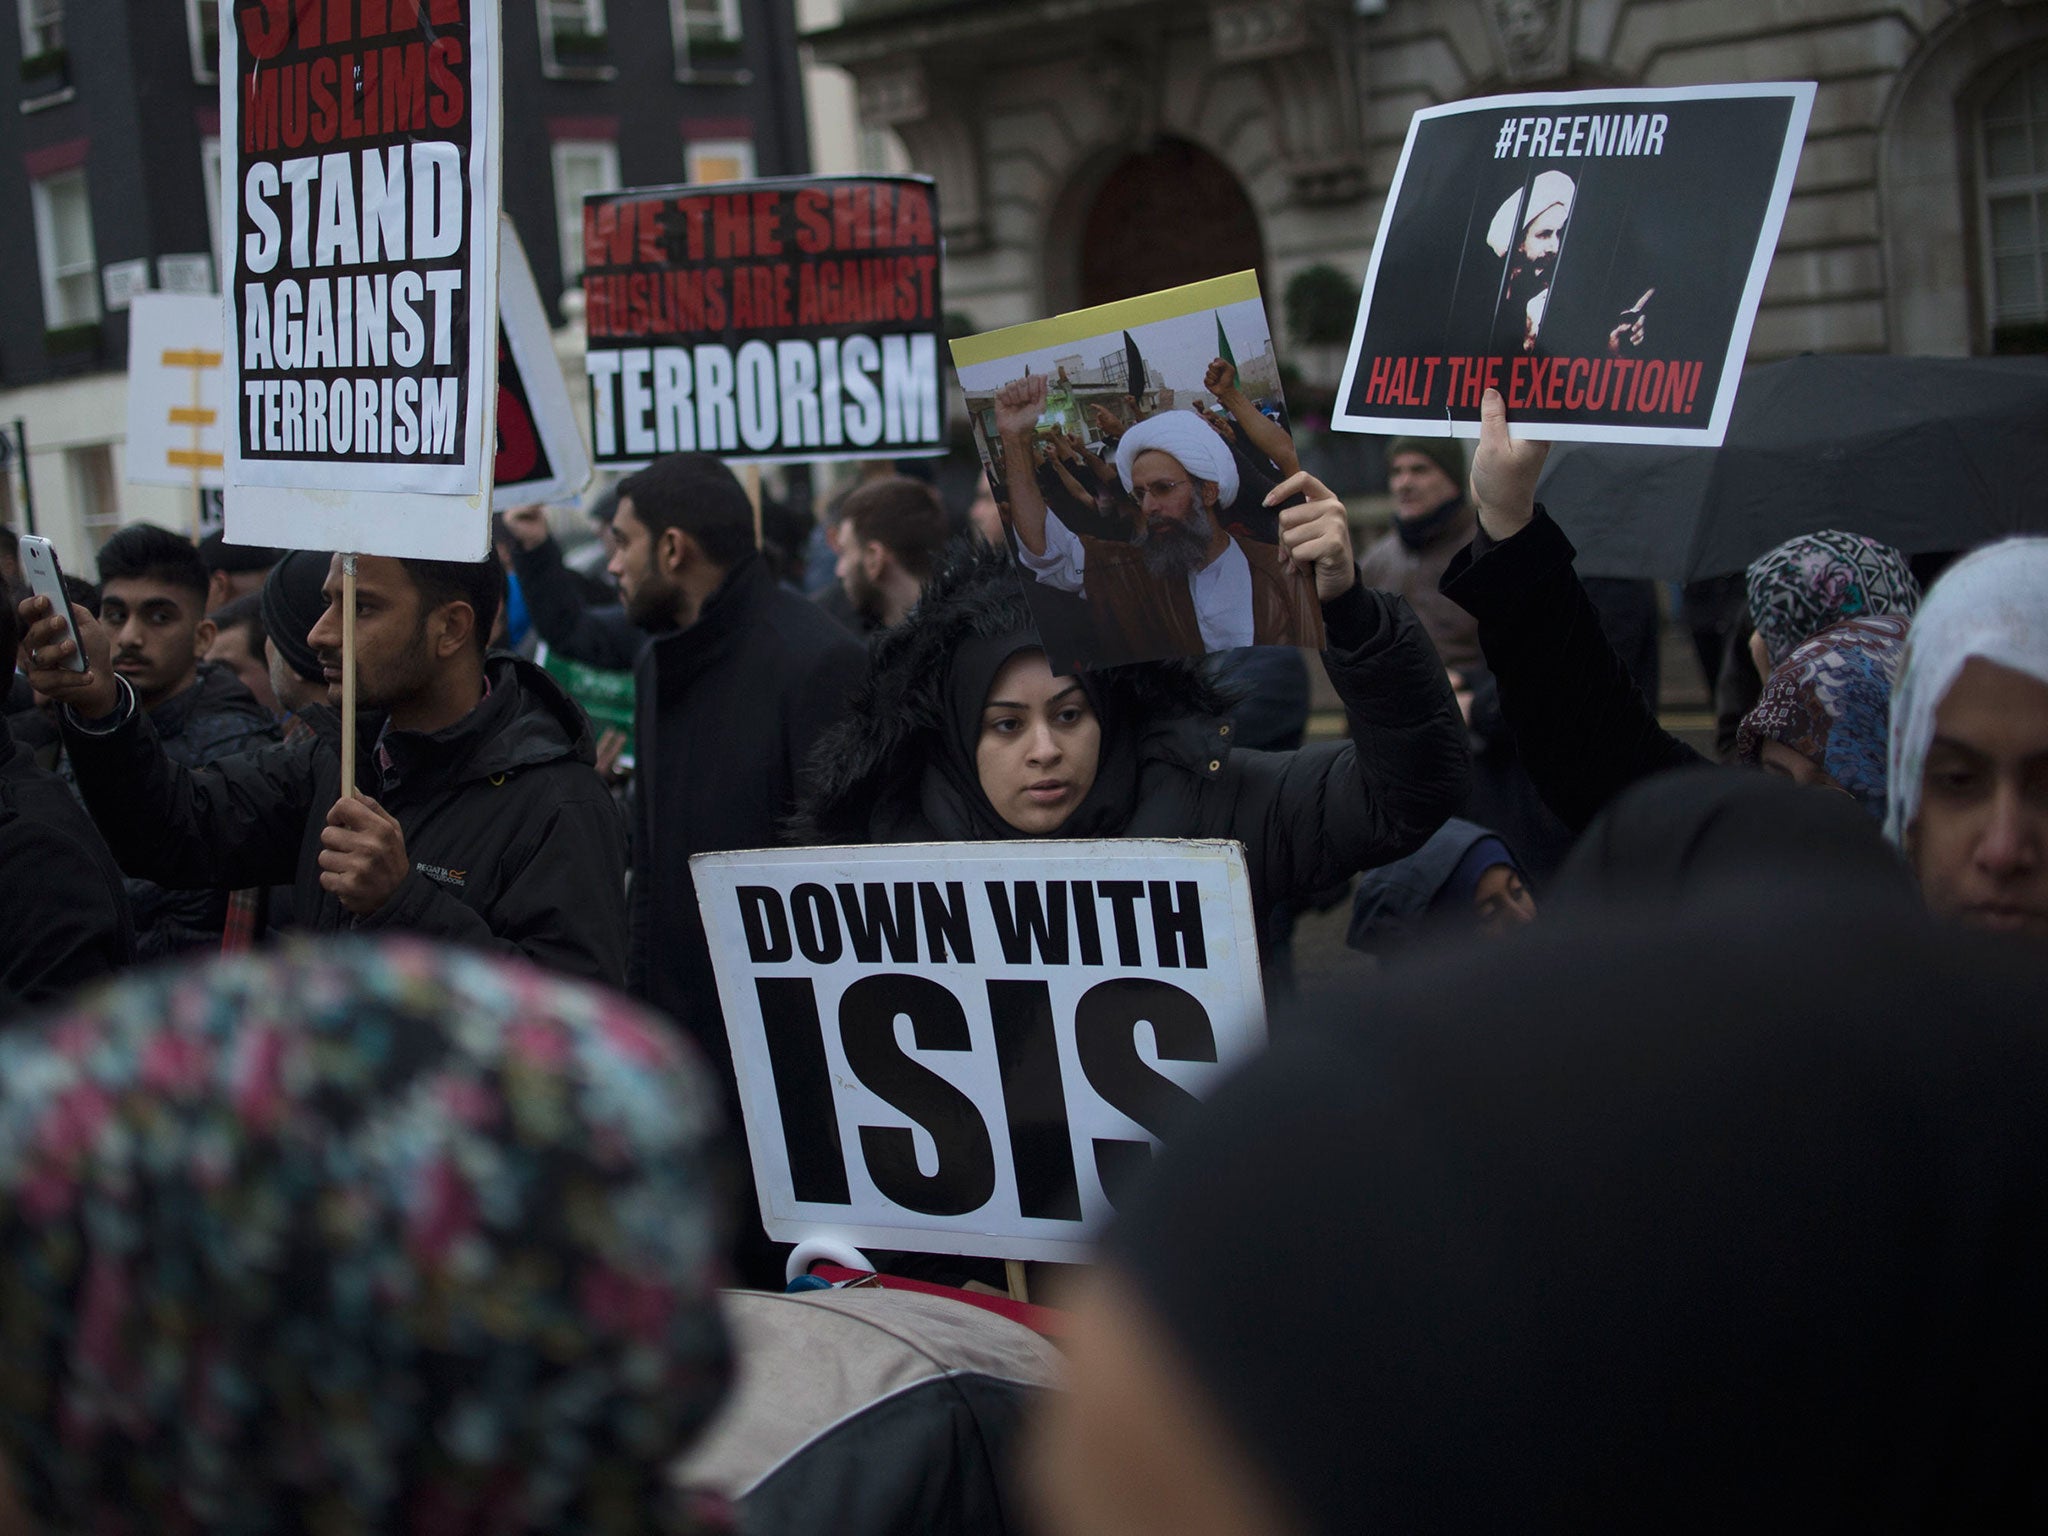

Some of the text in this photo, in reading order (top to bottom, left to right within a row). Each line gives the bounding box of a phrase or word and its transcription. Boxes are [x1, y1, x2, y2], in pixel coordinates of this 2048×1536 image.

[244, 37, 465, 153] MUSLIMS
[1494, 113, 1669, 159] #FREENIMR
[244, 140, 463, 274] STAND
[583, 182, 935, 267] WE THE SHIA
[244, 269, 462, 371] AGAINST
[733, 263, 793, 330] ARE
[800, 255, 938, 327] AGAINST
[245, 376, 459, 456] TERRORISM
[585, 332, 940, 456] TERRORISM
[1365, 356, 1703, 415] HALT THE EXECUTION!
[735, 880, 1208, 969] DOWN WITH
